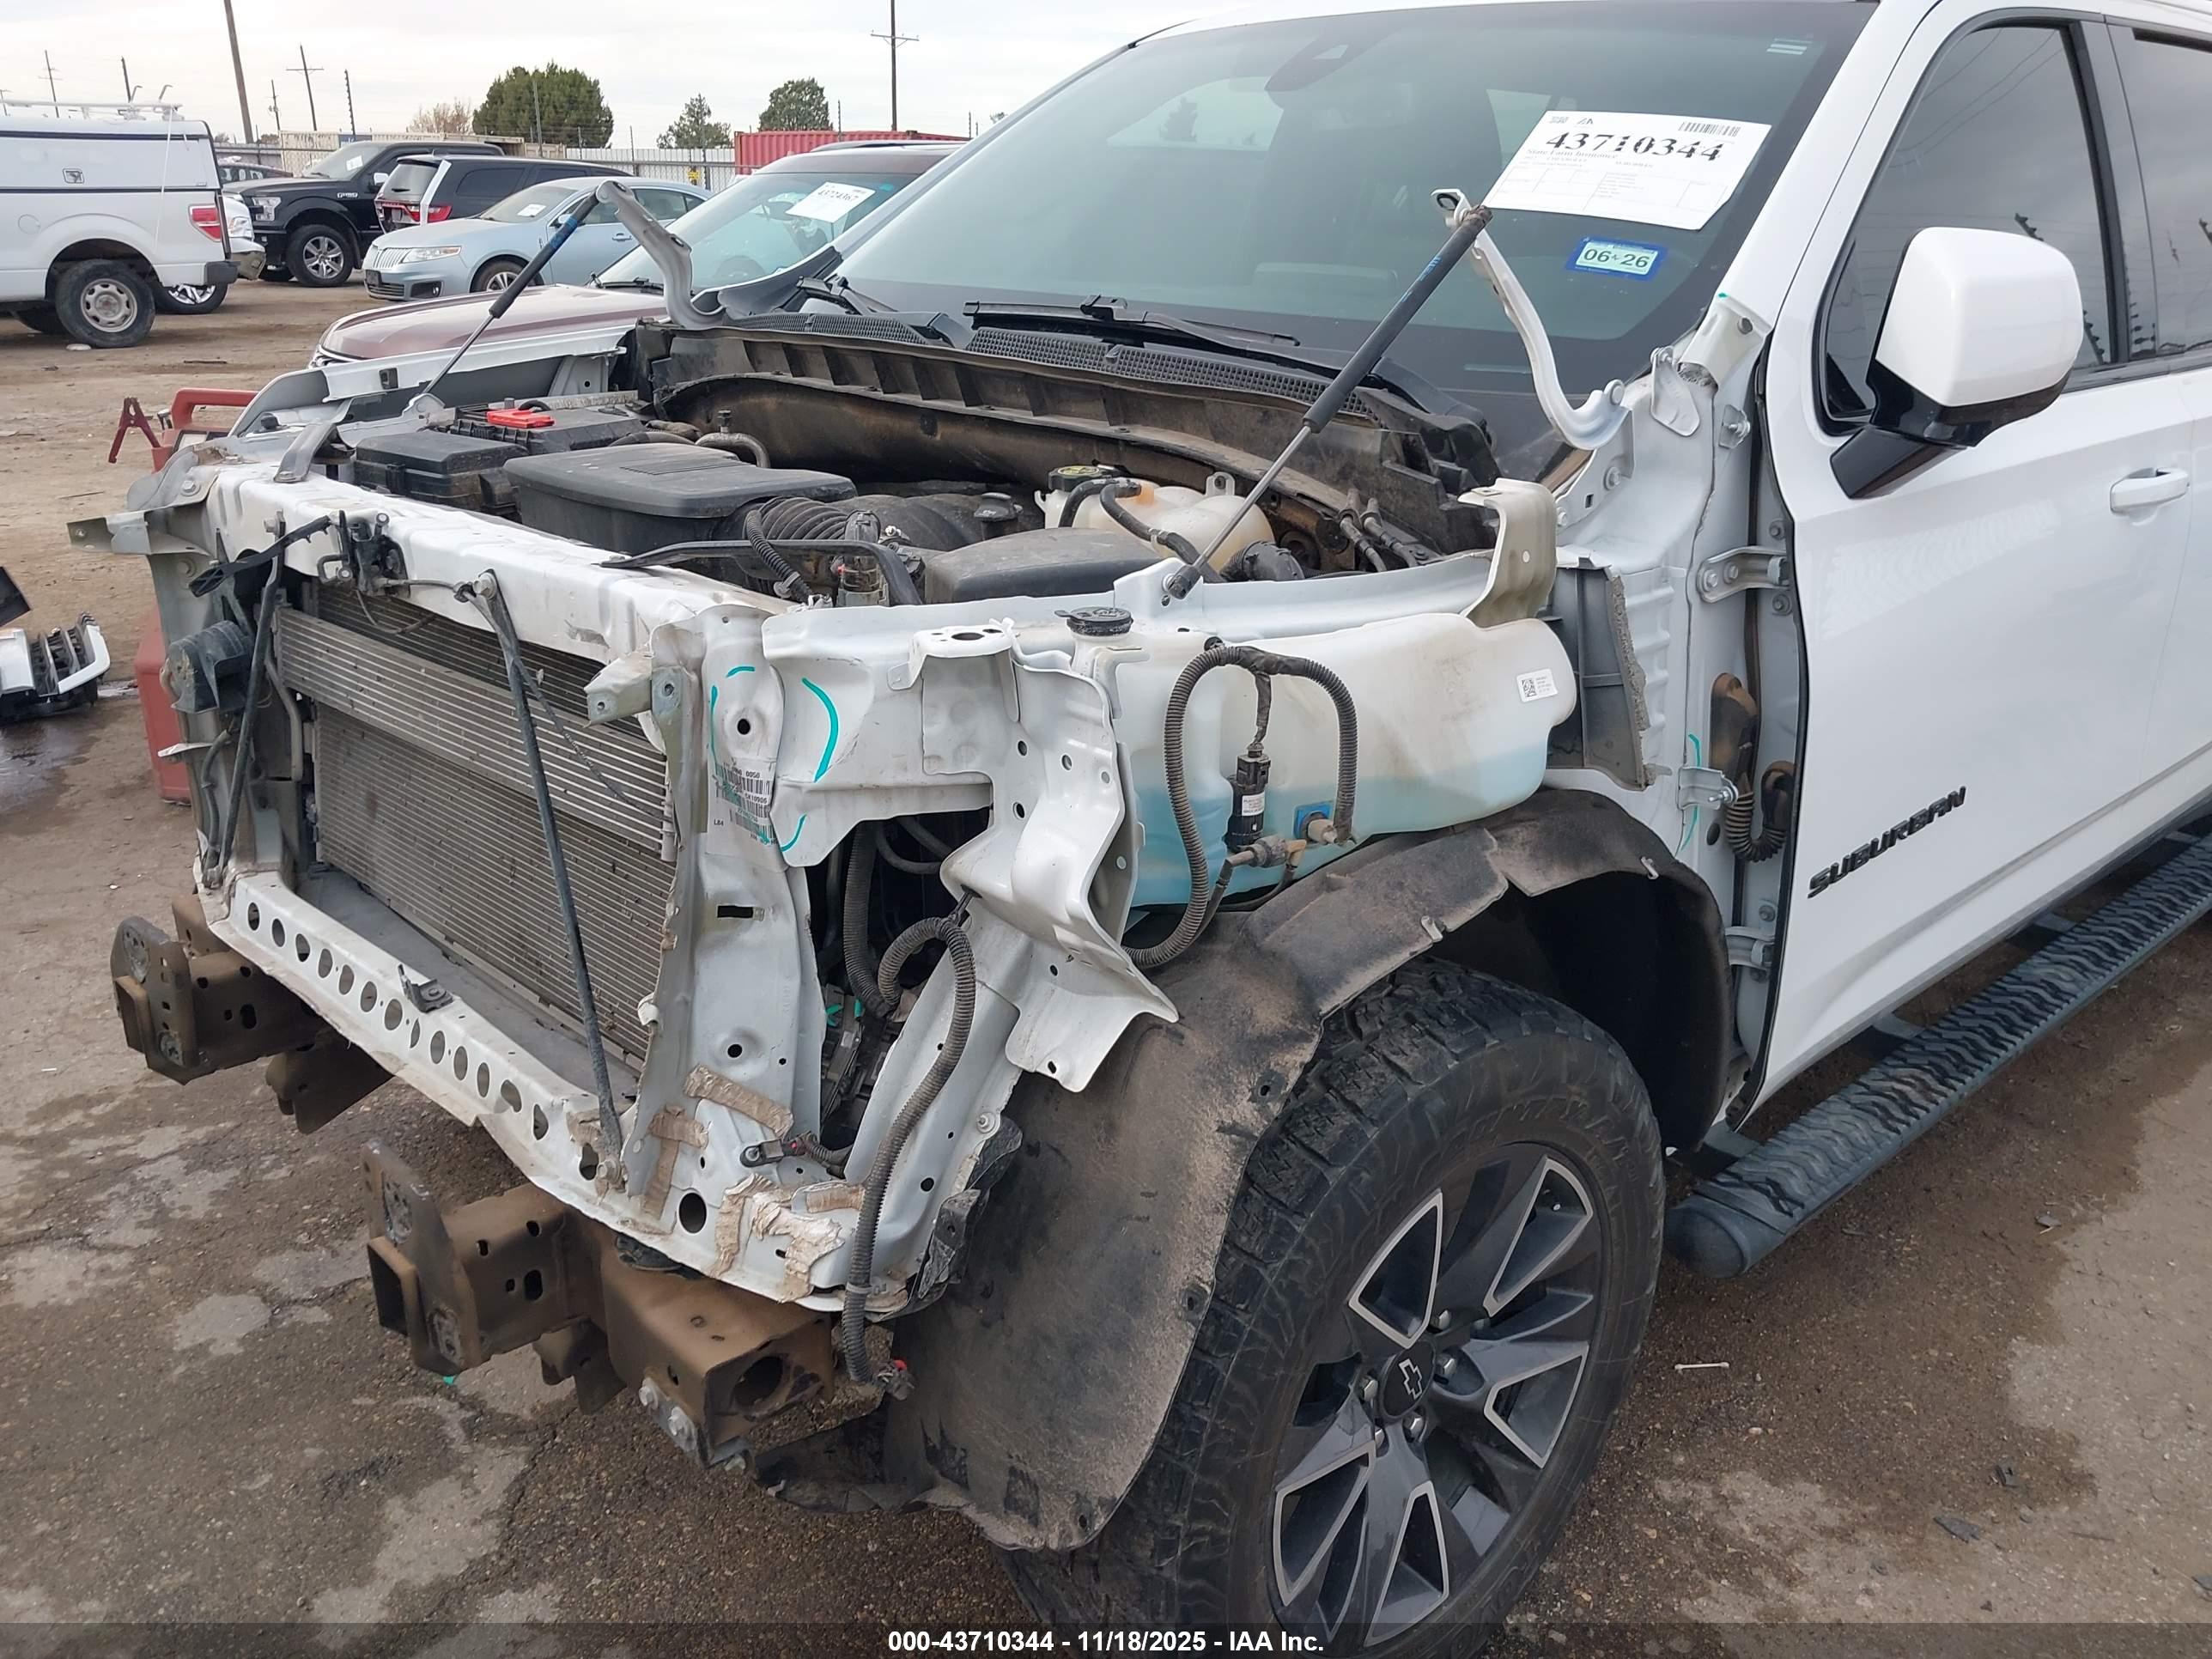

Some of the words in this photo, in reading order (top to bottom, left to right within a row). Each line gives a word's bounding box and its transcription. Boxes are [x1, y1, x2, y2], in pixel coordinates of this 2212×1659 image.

[1546, 131, 1723, 161] 43710344
[1583, 248, 1612, 263] 06
[1620, 253, 1650, 268] 26
[1808, 786, 1966, 898] SUBURBAN
